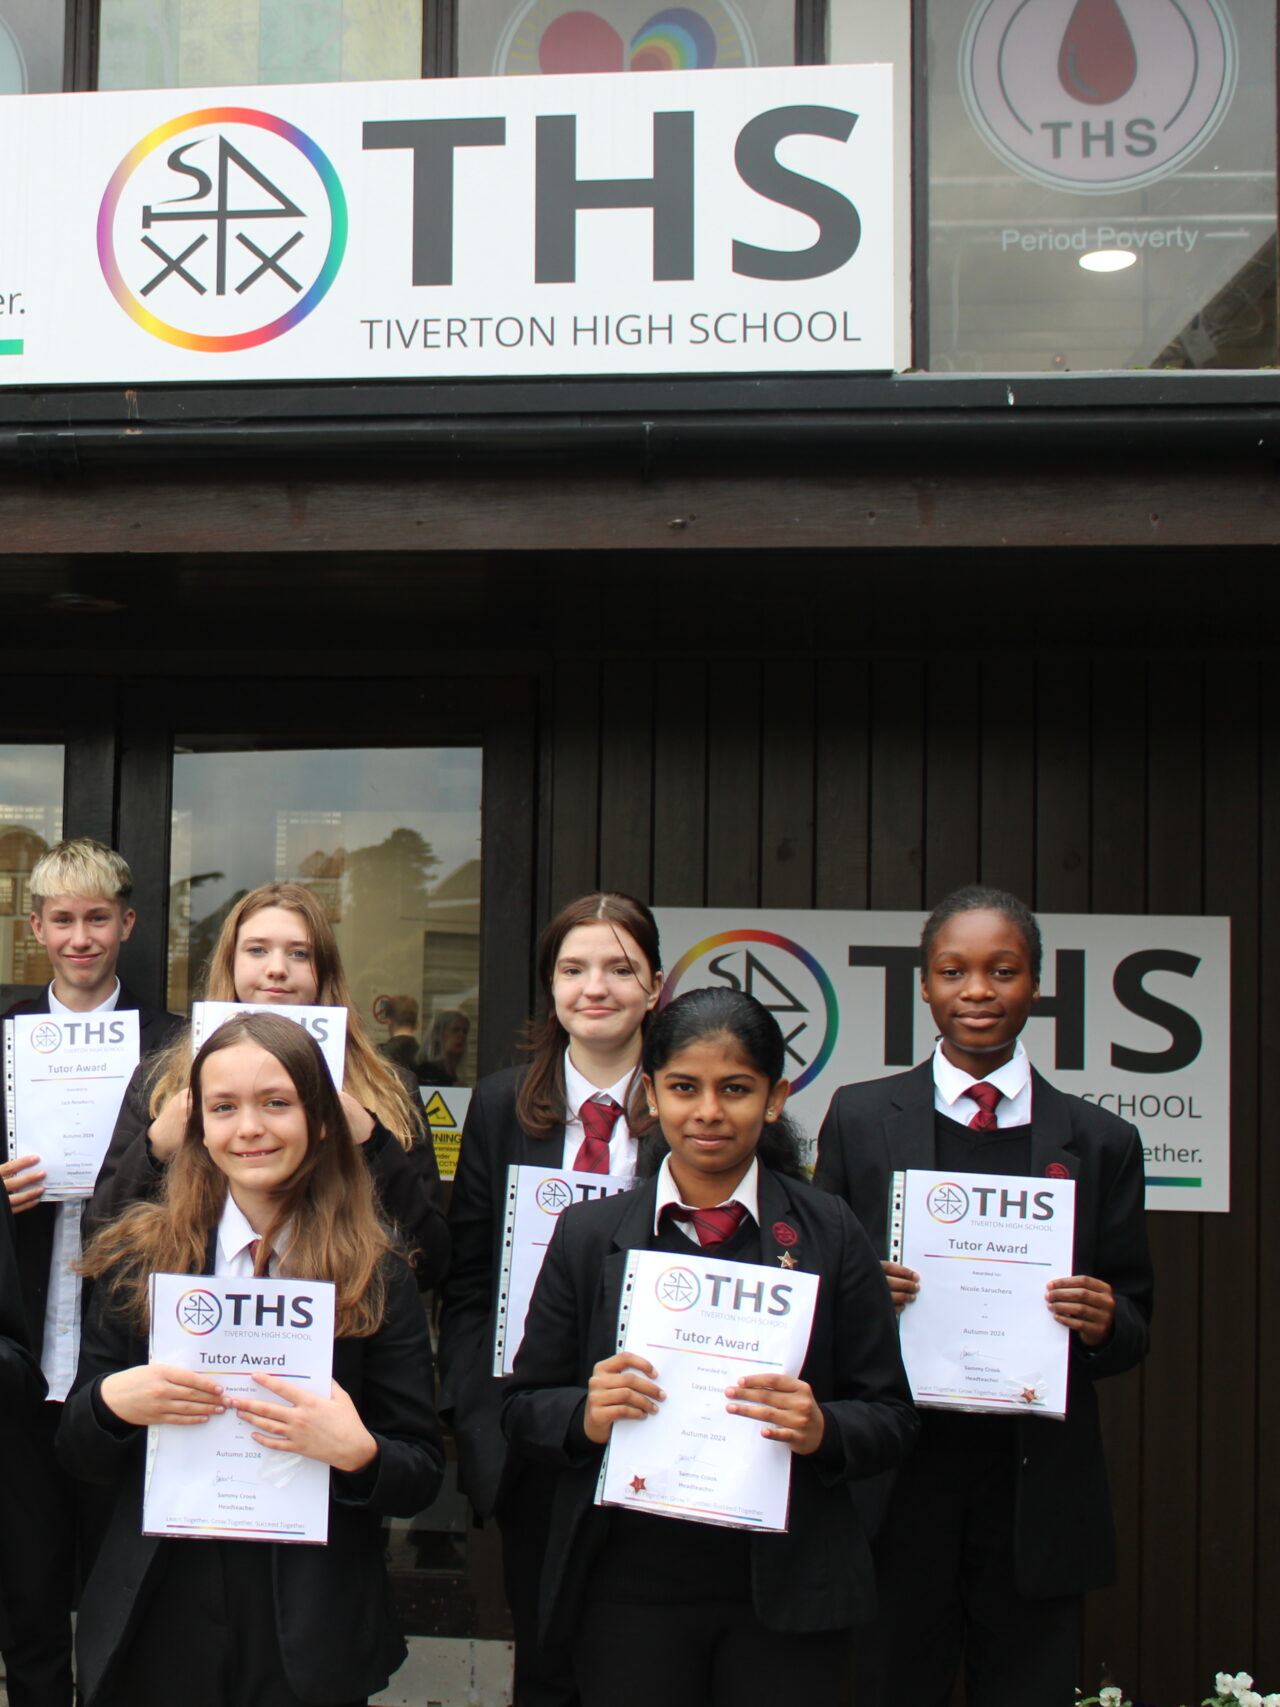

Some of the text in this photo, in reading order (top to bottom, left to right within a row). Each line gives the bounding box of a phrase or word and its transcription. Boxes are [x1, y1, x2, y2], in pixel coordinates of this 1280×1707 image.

[1040, 118, 1157, 159] THS
[362, 104, 861, 286] THS
[1001, 226, 1198, 252] Period Poverty
[361, 309, 861, 349] TIVERTON HIGH SCHOOL
[64, 1021, 124, 1045] THS
[48, 1063, 107, 1073] Tutor Award
[1082, 1094, 1202, 1118] CHOOL
[433, 1133, 462, 1144] NING
[1143, 1144, 1202, 1162] ether.
[972, 1187, 1054, 1220] THS
[971, 1219, 1053, 1232] TIVERTON HIGH SCHOOL
[948, 1239, 1028, 1254] Tutor Award
[705, 1274, 793, 1316] THS
[225, 1294, 314, 1328] THS
[224, 1330, 312, 1341] TIVERTON HIGH SCHOOL
[674, 1328, 760, 1352] Tutor Award
[963, 1328, 988, 1336] Autumn
[200, 1352, 286, 1366] Tutor Award
[681, 1429, 726, 1442] Autumn 2024
[216, 1450, 244, 1458] Autumn
